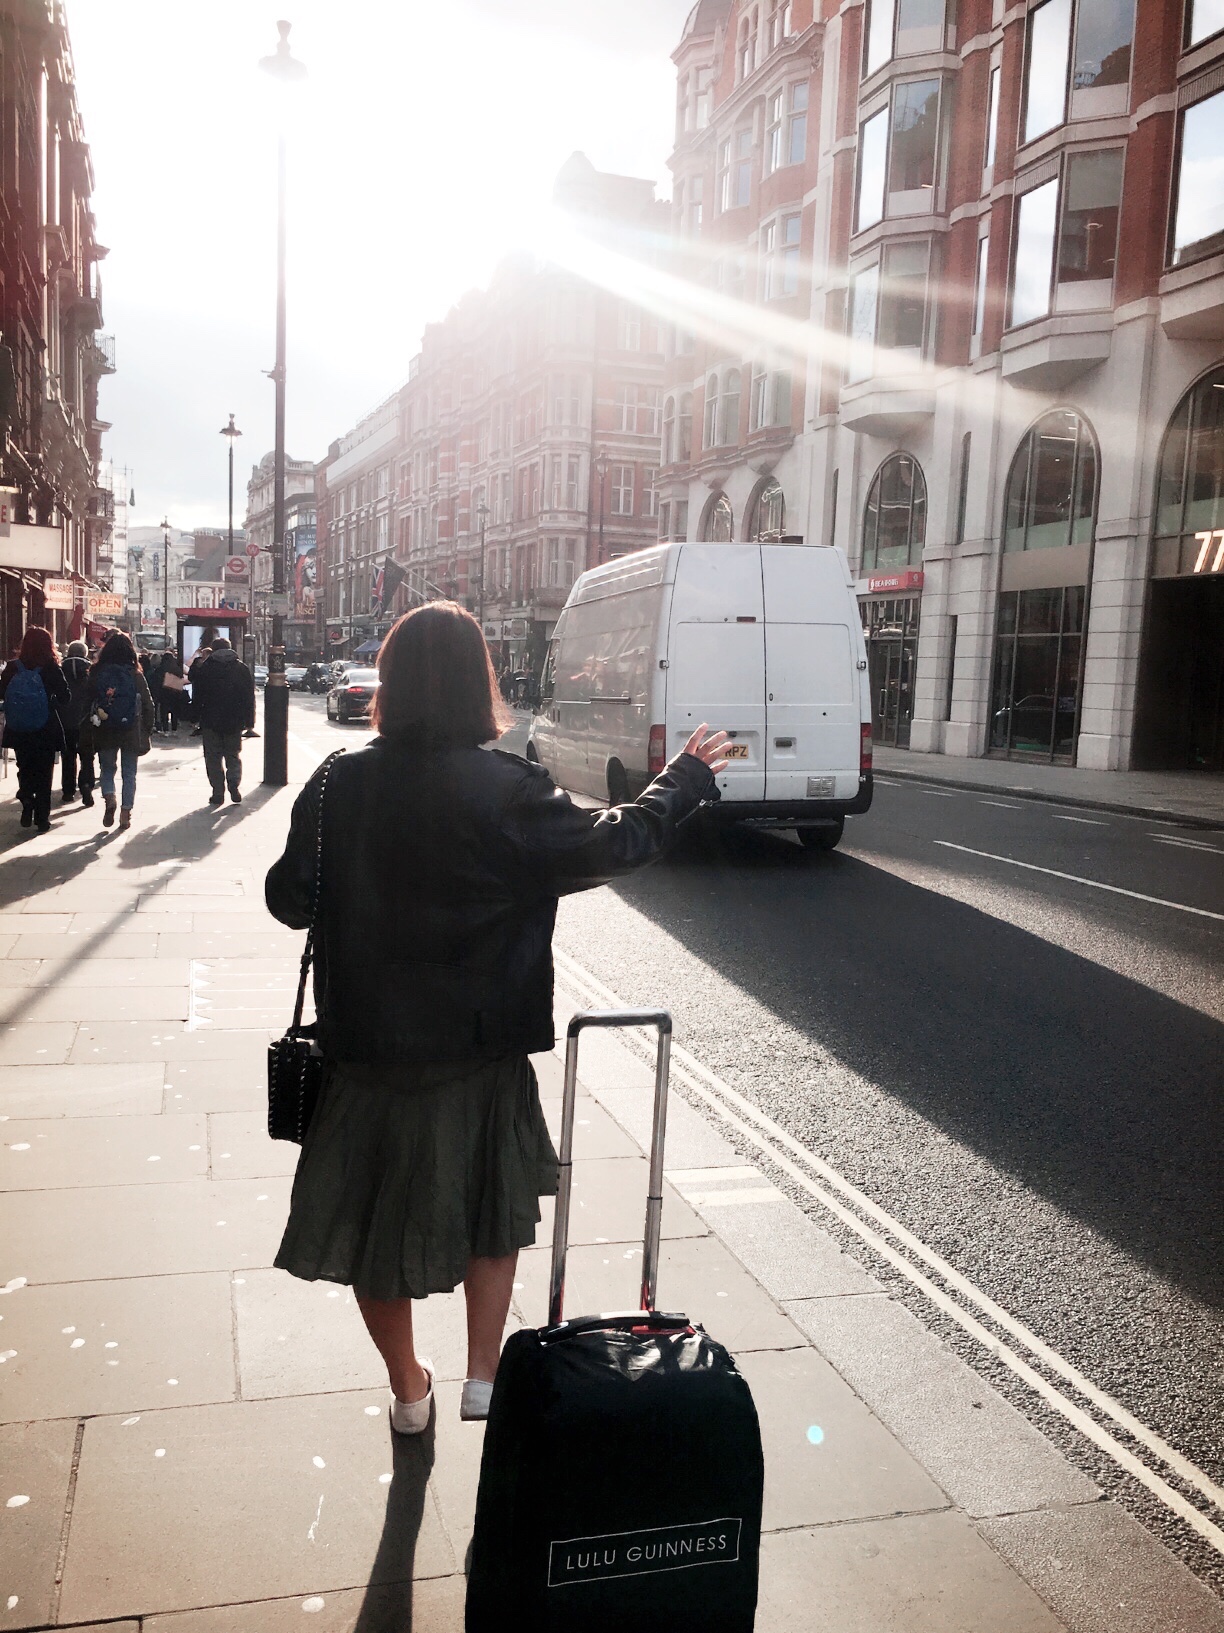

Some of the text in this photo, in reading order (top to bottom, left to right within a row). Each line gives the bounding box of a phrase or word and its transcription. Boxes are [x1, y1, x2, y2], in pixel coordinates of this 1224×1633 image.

[1193, 529, 1224, 573] 77
[49, 583, 72, 594] MASSAGE
[89, 598, 121, 609] OPEN
[725, 746, 747, 757] RPZ
[566, 1534, 727, 1570] LULU GUINNESS
